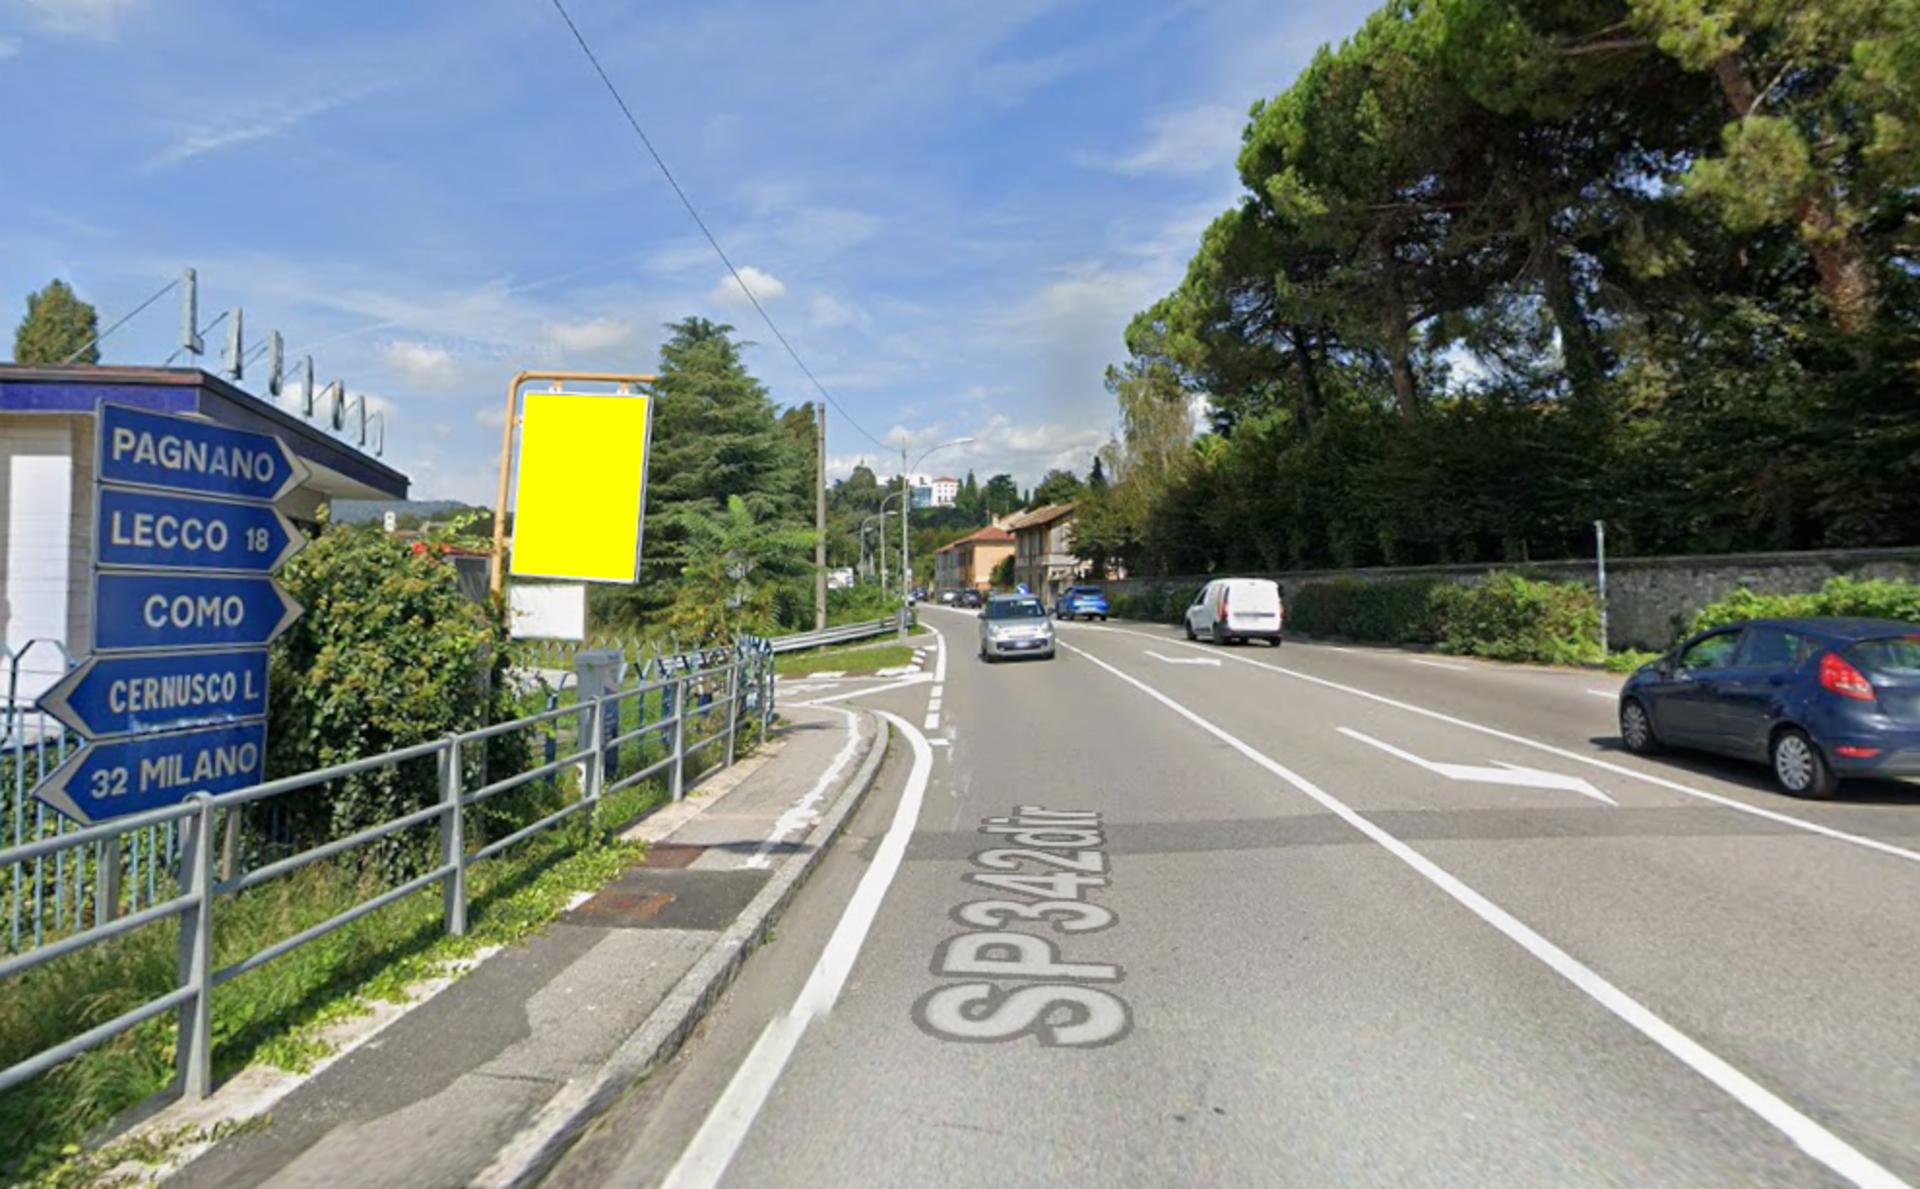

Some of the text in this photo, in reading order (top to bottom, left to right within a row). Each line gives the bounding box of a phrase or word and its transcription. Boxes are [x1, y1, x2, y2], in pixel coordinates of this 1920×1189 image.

[112, 427, 275, 483] PAGNANO
[111, 511, 269, 552] LECCO 18
[143, 594, 244, 629] COMO
[109, 671, 237, 713] CERNUSCO
[90, 742, 257, 799] 32 MILANO
